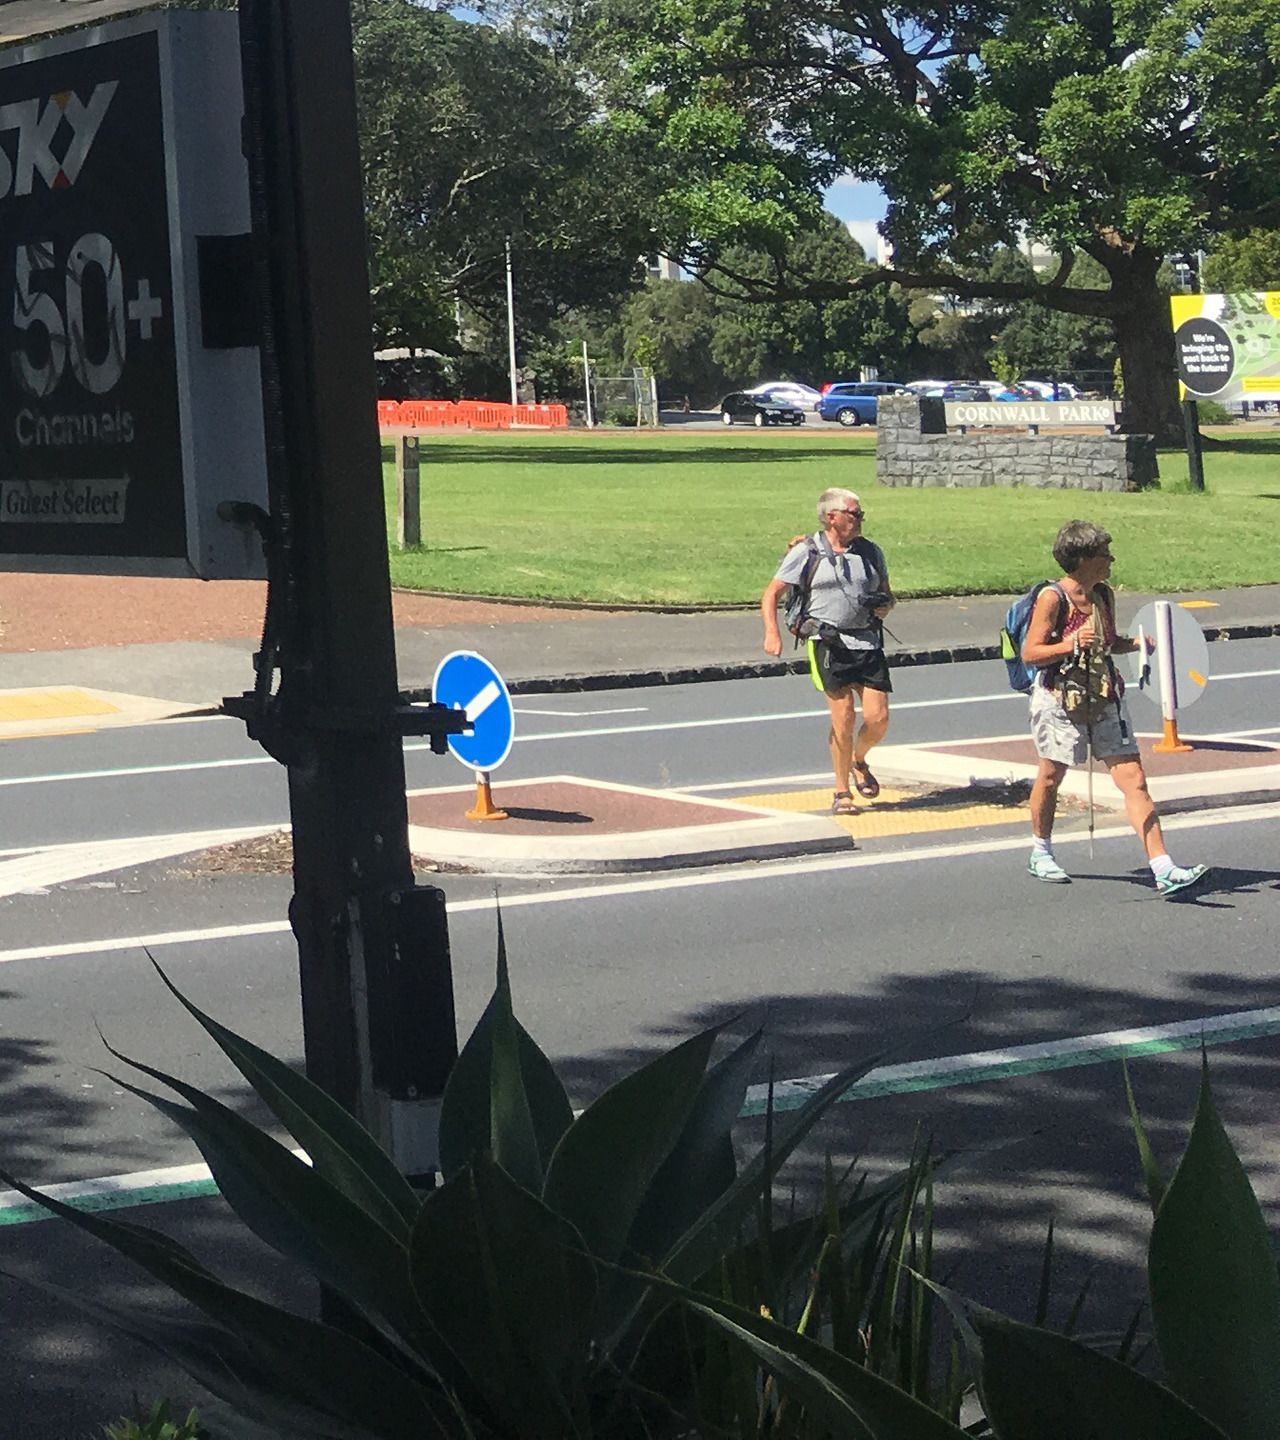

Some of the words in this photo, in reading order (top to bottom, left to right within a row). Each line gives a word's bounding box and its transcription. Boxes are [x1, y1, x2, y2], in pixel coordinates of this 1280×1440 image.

[11, 232, 162, 398] 50+
[1181, 344, 1214, 354] bringing
[1215, 344, 1229, 352] the
[1183, 355, 1200, 364] past
[1201, 354, 1220, 362] back
[1220, 354, 1230, 362] to
[1186, 364, 1200, 373] the
[954, 406, 1050, 422] CORNWALL
[1059, 406, 1105, 421] PARK
[15, 408, 135, 447] Channels
[6, 489, 59, 515] Guest
[63, 486, 120, 515] Select
